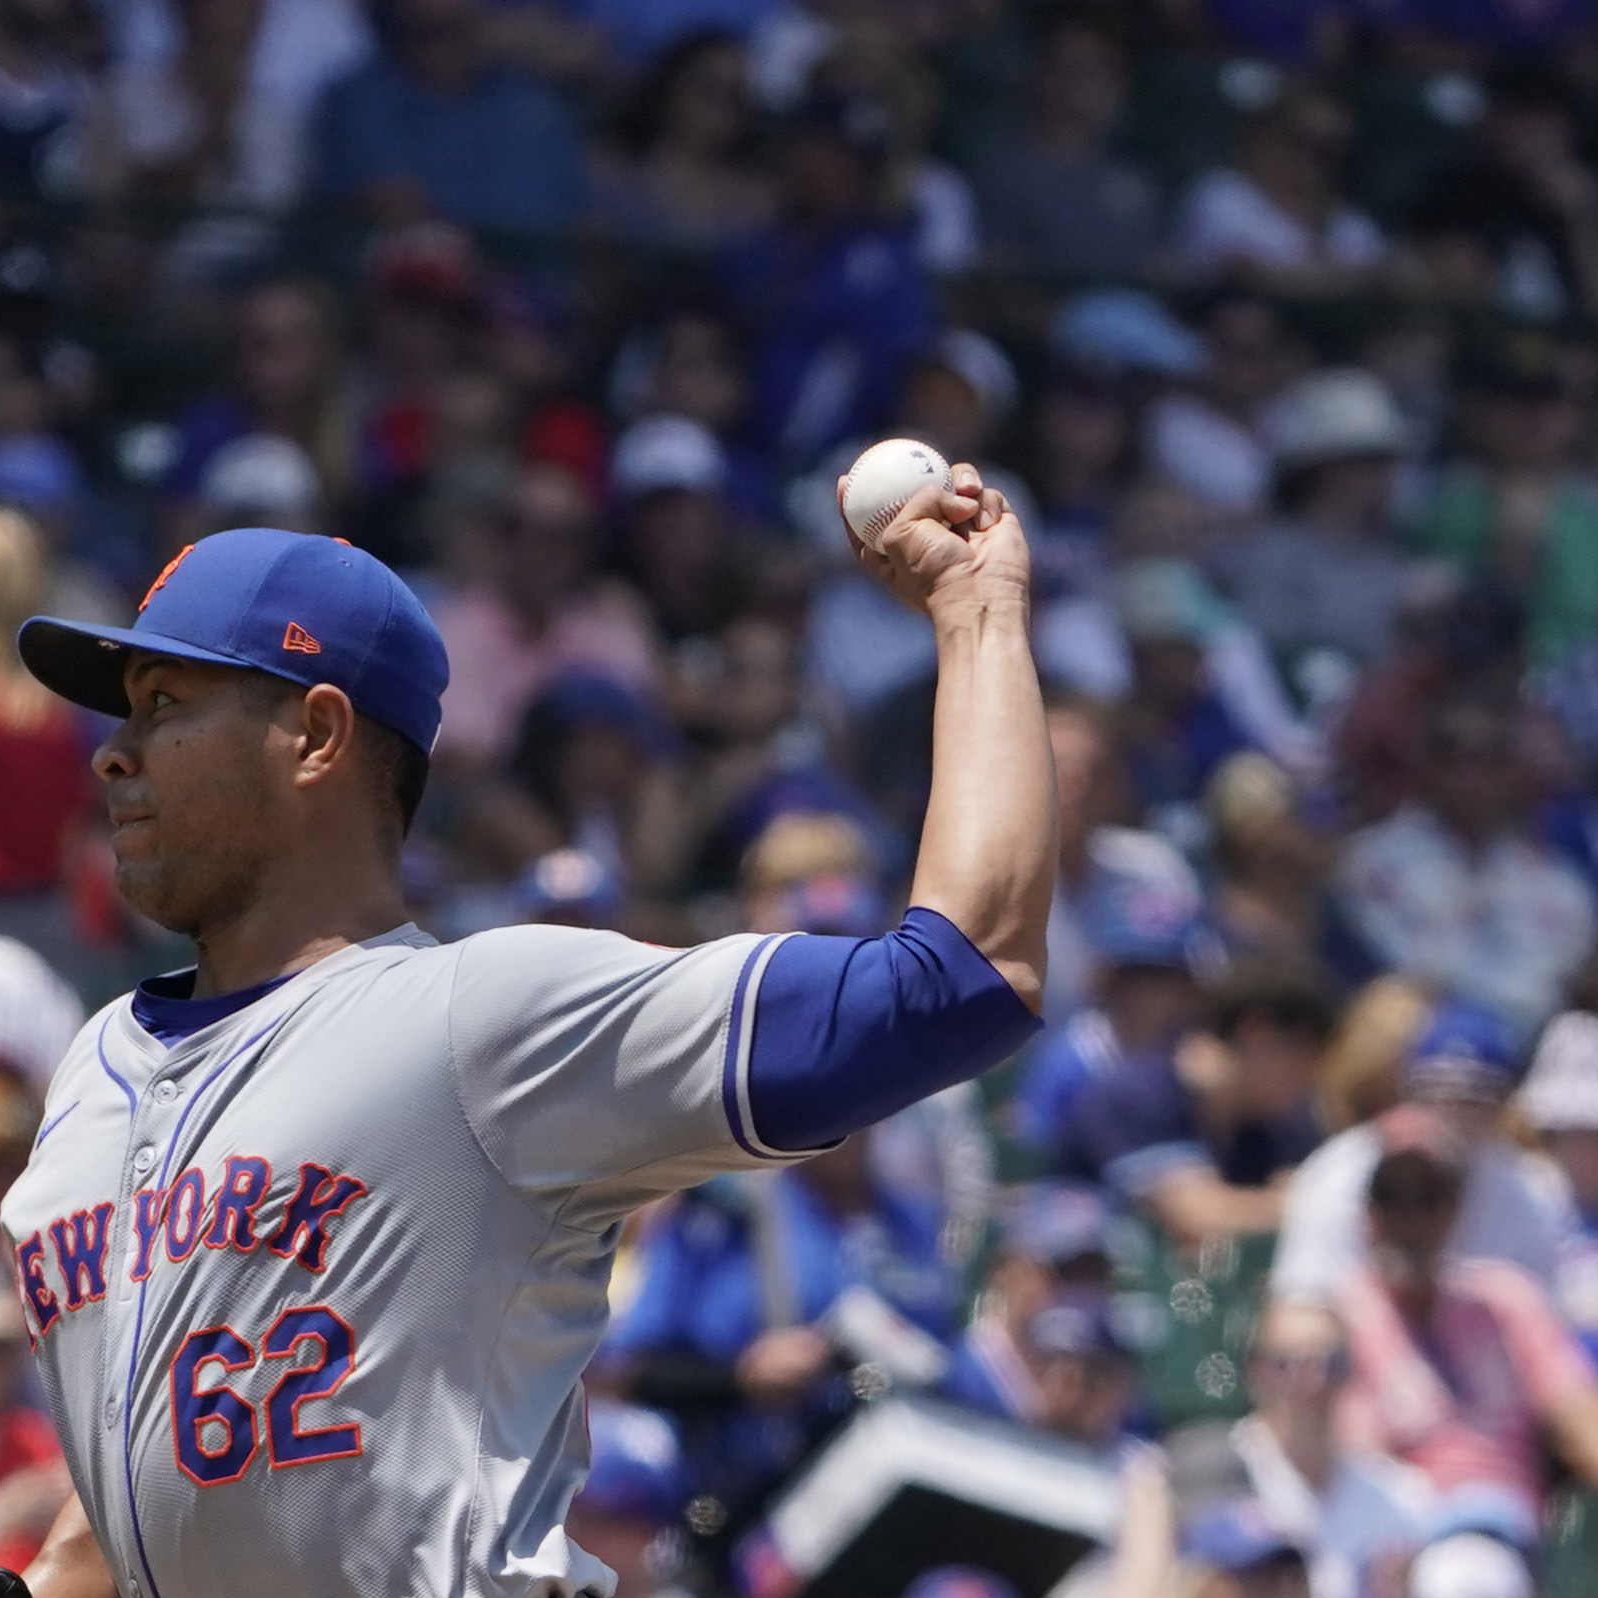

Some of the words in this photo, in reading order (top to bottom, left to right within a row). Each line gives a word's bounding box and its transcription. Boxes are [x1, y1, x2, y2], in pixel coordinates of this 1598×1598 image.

[16, 1202, 114, 1353] EW
[130, 1155, 368, 1283] YORK
[170, 1305, 363, 1488] 62
